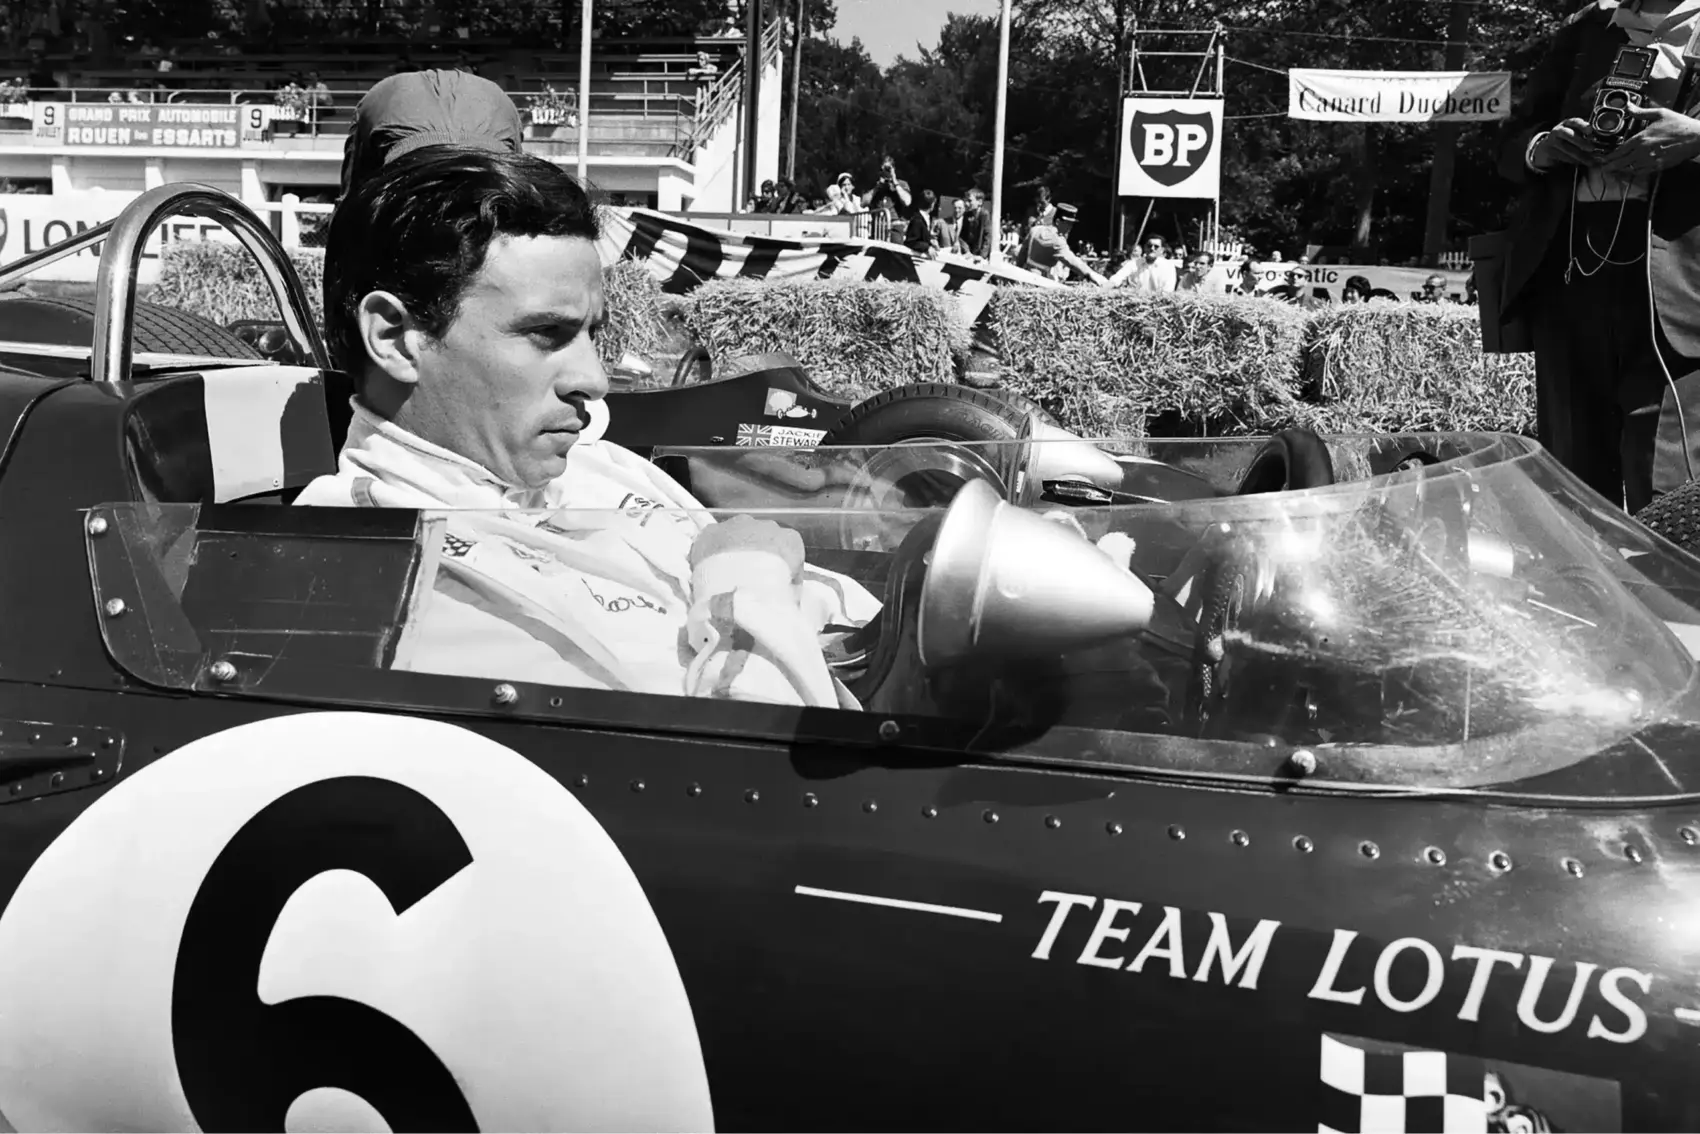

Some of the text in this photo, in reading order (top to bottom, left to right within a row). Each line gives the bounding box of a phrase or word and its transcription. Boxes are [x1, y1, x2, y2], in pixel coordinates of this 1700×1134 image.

[1299, 87, 1500, 115] Canard Duchêne
[44, 105, 55, 126] 9
[68, 107, 237, 124] GRAND PRIX AUTOMOBILE
[250, 108, 262, 129] 9
[67, 127, 131, 145] ROUEN
[152, 128, 237, 147] ESSARTS
[1140, 123, 1208, 167] BP
[772, 435, 821, 447] STEWAR
[171, 775, 481, 1133] 6
[1031, 890, 1654, 1043] TEAM LOTUS
